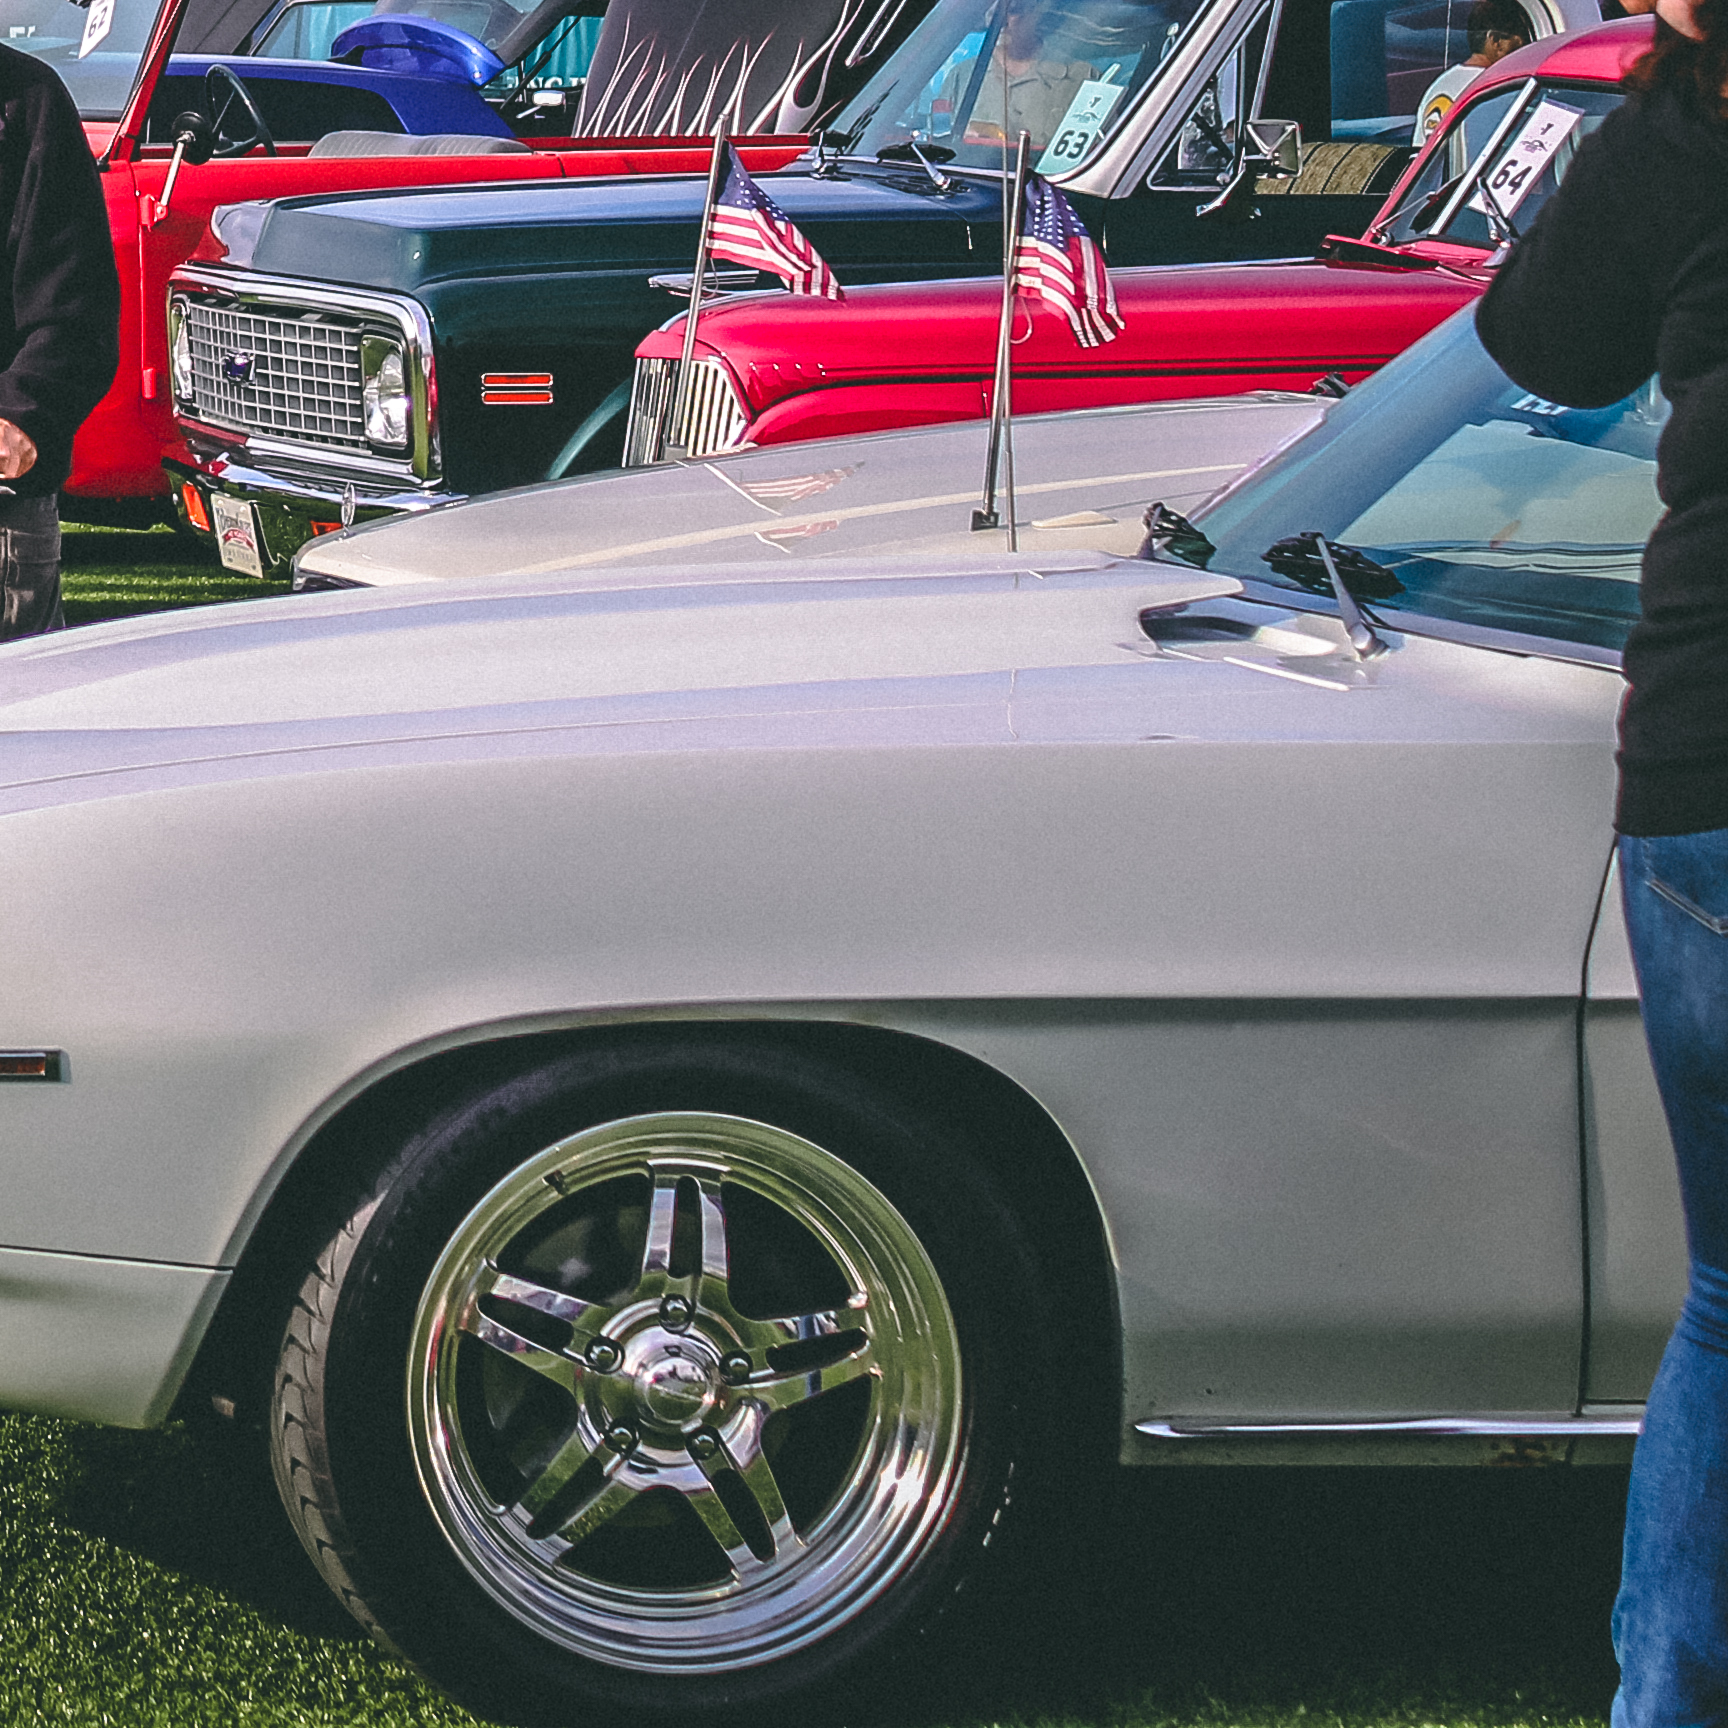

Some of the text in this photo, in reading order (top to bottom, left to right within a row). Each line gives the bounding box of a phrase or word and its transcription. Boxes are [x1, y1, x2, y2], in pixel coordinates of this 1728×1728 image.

[87, 5, 109, 39] 62
[1053, 129, 1089, 159] 63
[1491, 158, 1533, 196] 64
